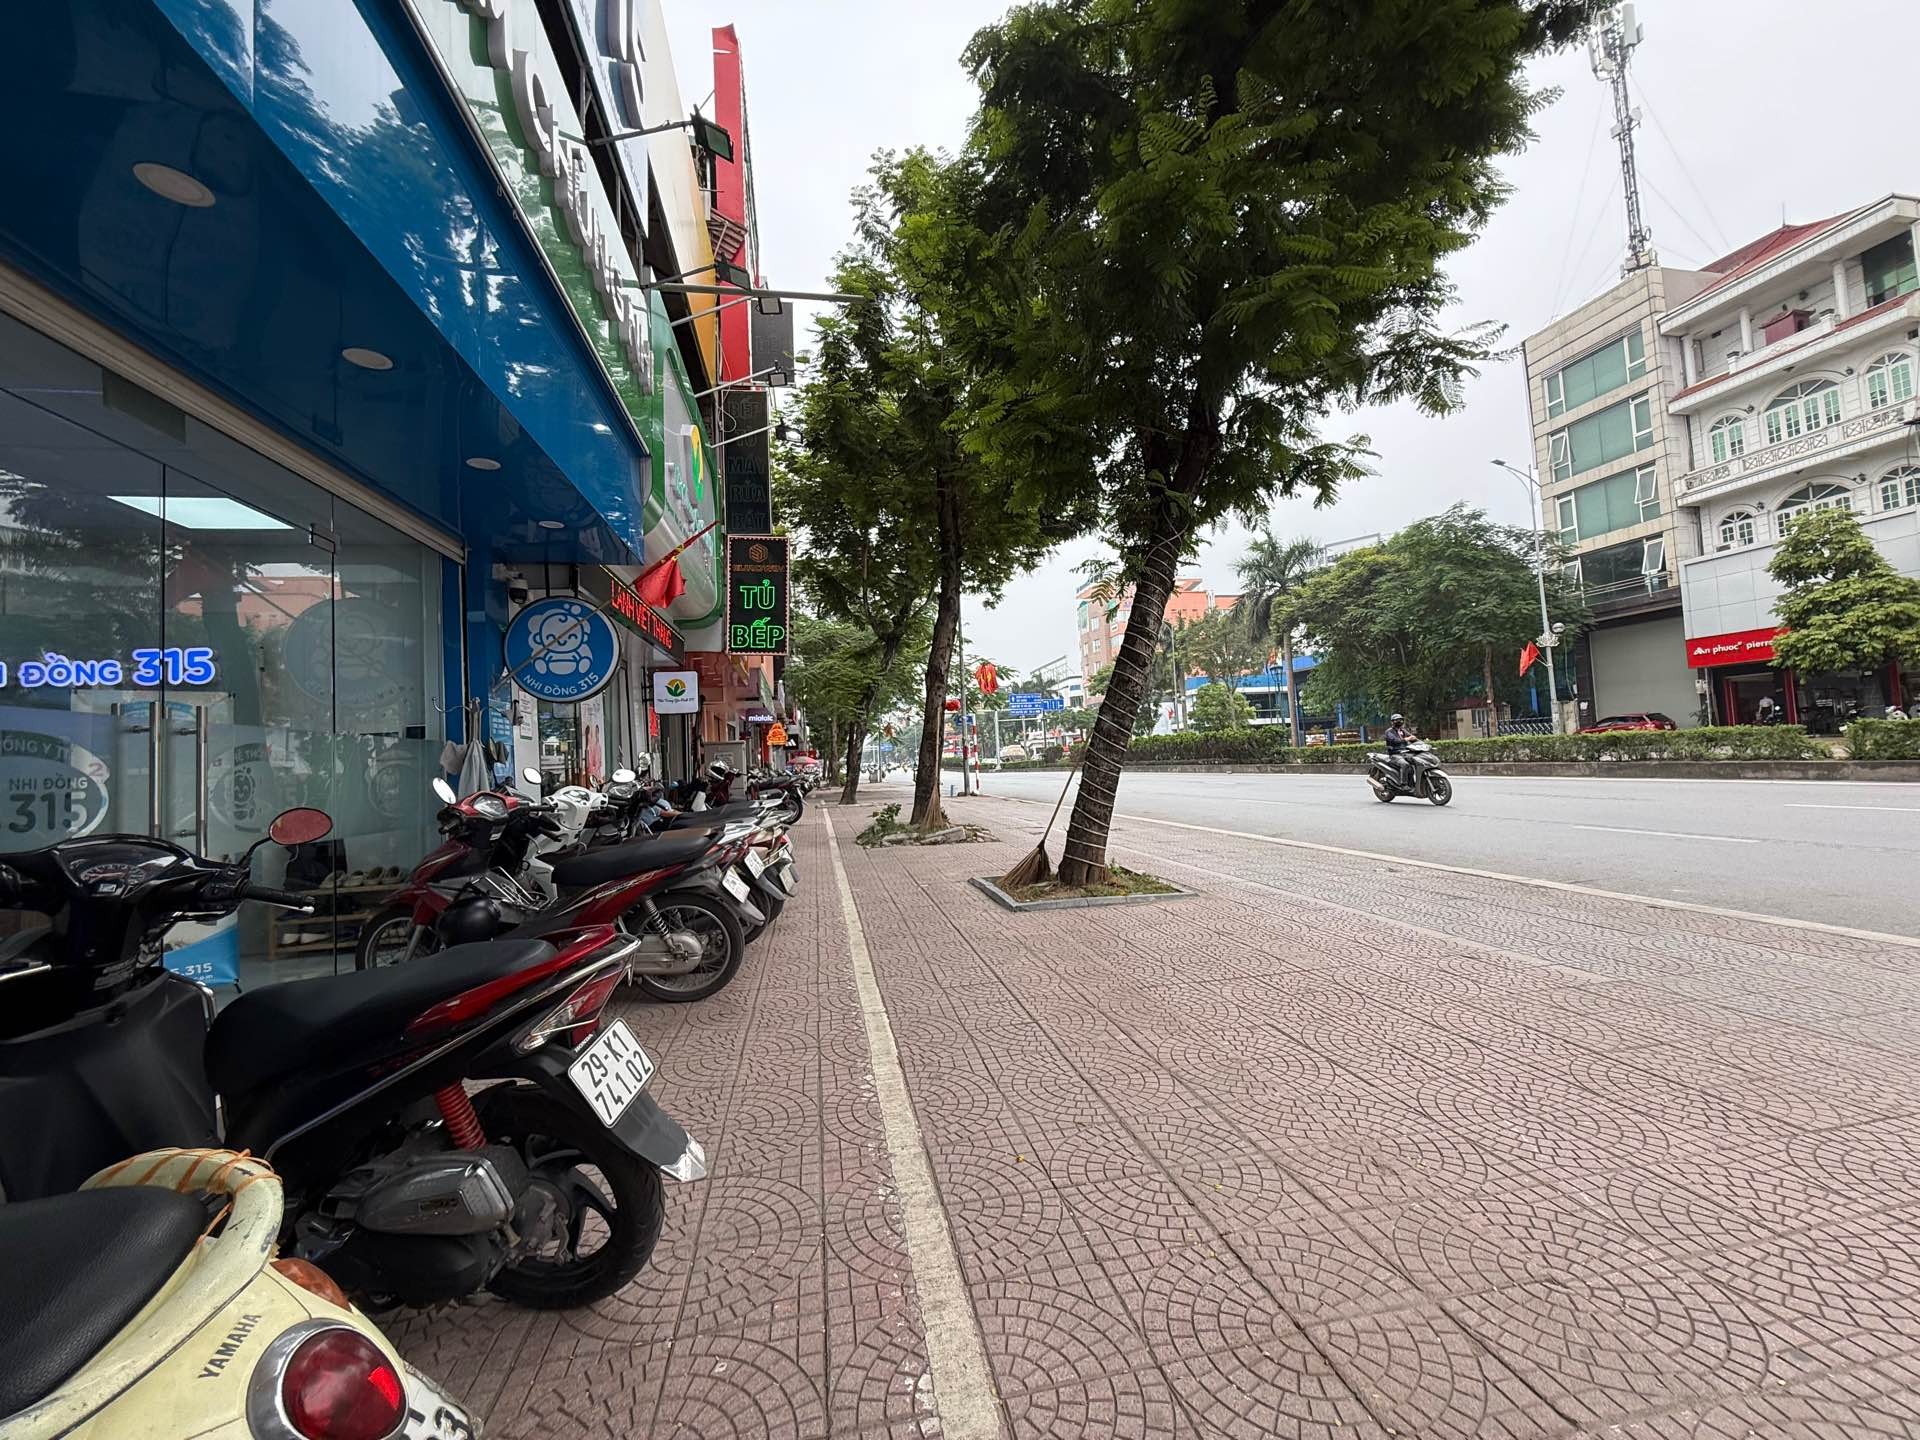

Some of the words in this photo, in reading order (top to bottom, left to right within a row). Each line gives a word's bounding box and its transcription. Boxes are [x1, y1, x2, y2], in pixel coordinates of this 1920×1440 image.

[740, 579, 775, 610] TỦ
[731, 616, 785, 648] BẾP
[18, 652, 122, 687] ĐỒNG
[132, 648, 215, 686] 315
[523, 674, 542, 690] NHI
[544, 683, 578, 696] ĐỒNG
[577, 672, 600, 691] 315
[9, 777, 38, 791] NHI
[43, 773, 88, 790] ĐỒNG
[9, 792, 88, 833] 315
[581, 1030, 629, 1088] 29-K1
[595, 1050, 651, 1120] 741.02
[198, 1314, 262, 1378] YAMAHA
